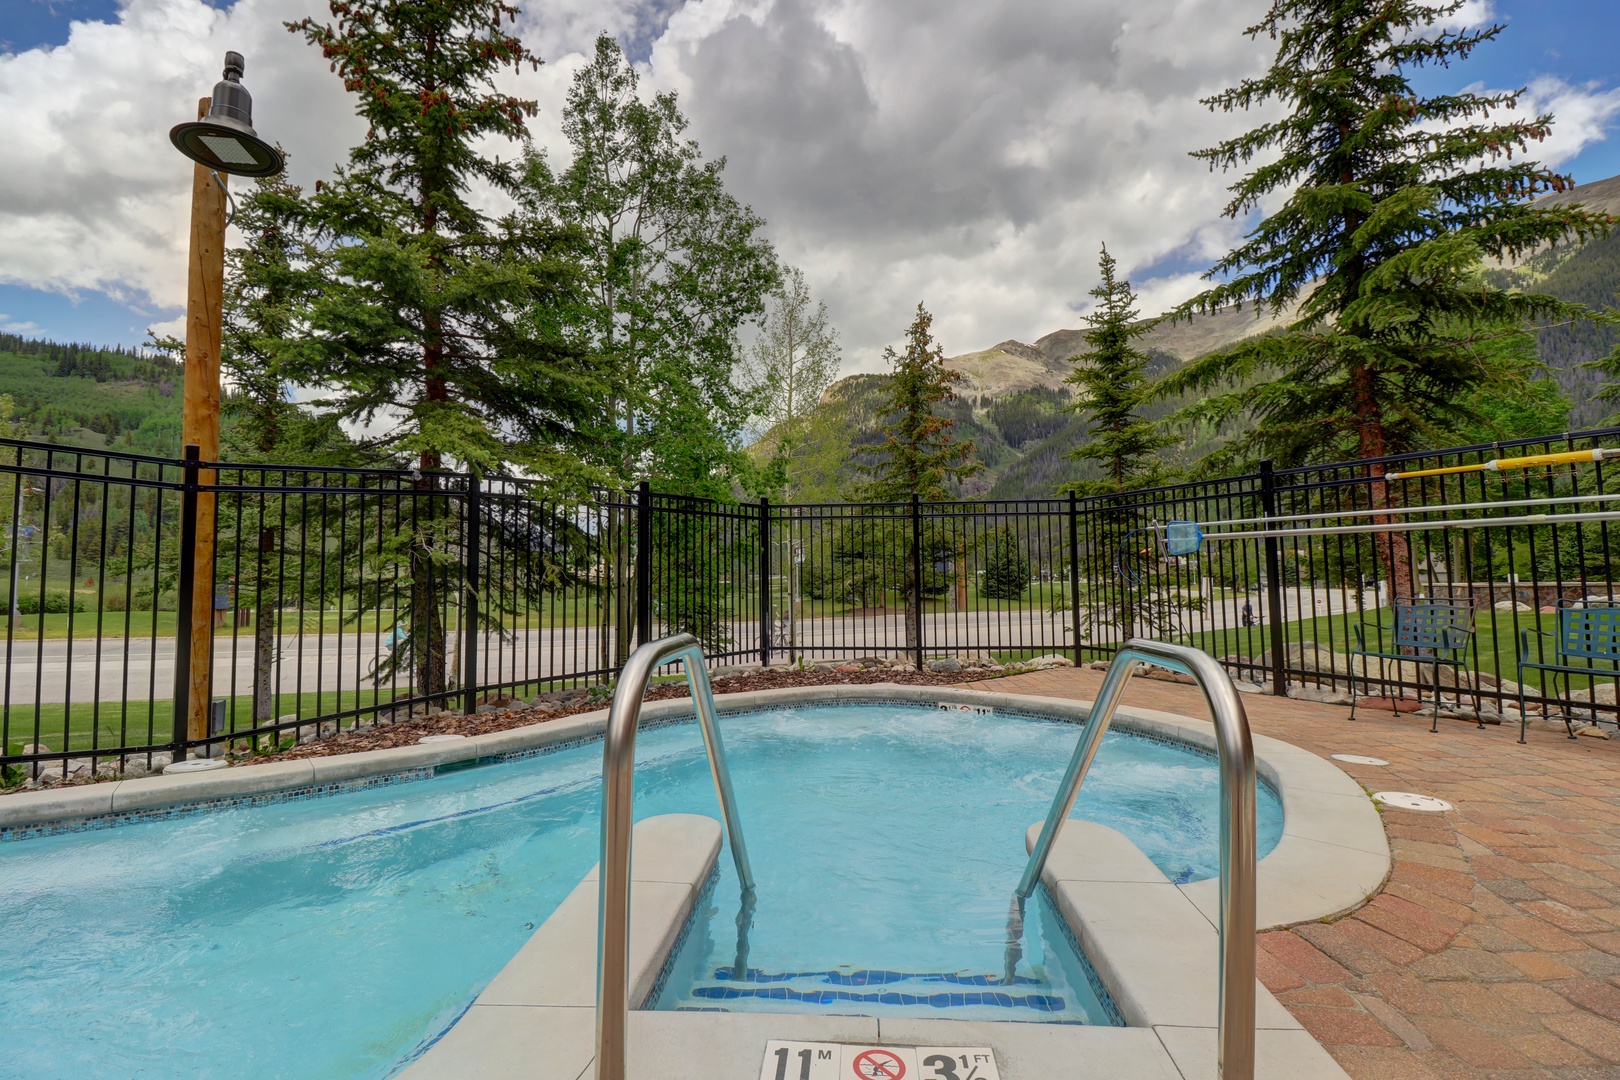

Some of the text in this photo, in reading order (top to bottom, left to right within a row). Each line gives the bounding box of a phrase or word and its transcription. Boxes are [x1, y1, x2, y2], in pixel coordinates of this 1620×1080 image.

[774, 1048, 832, 1080] 11 M
[973, 1054, 990, 1063] FT
